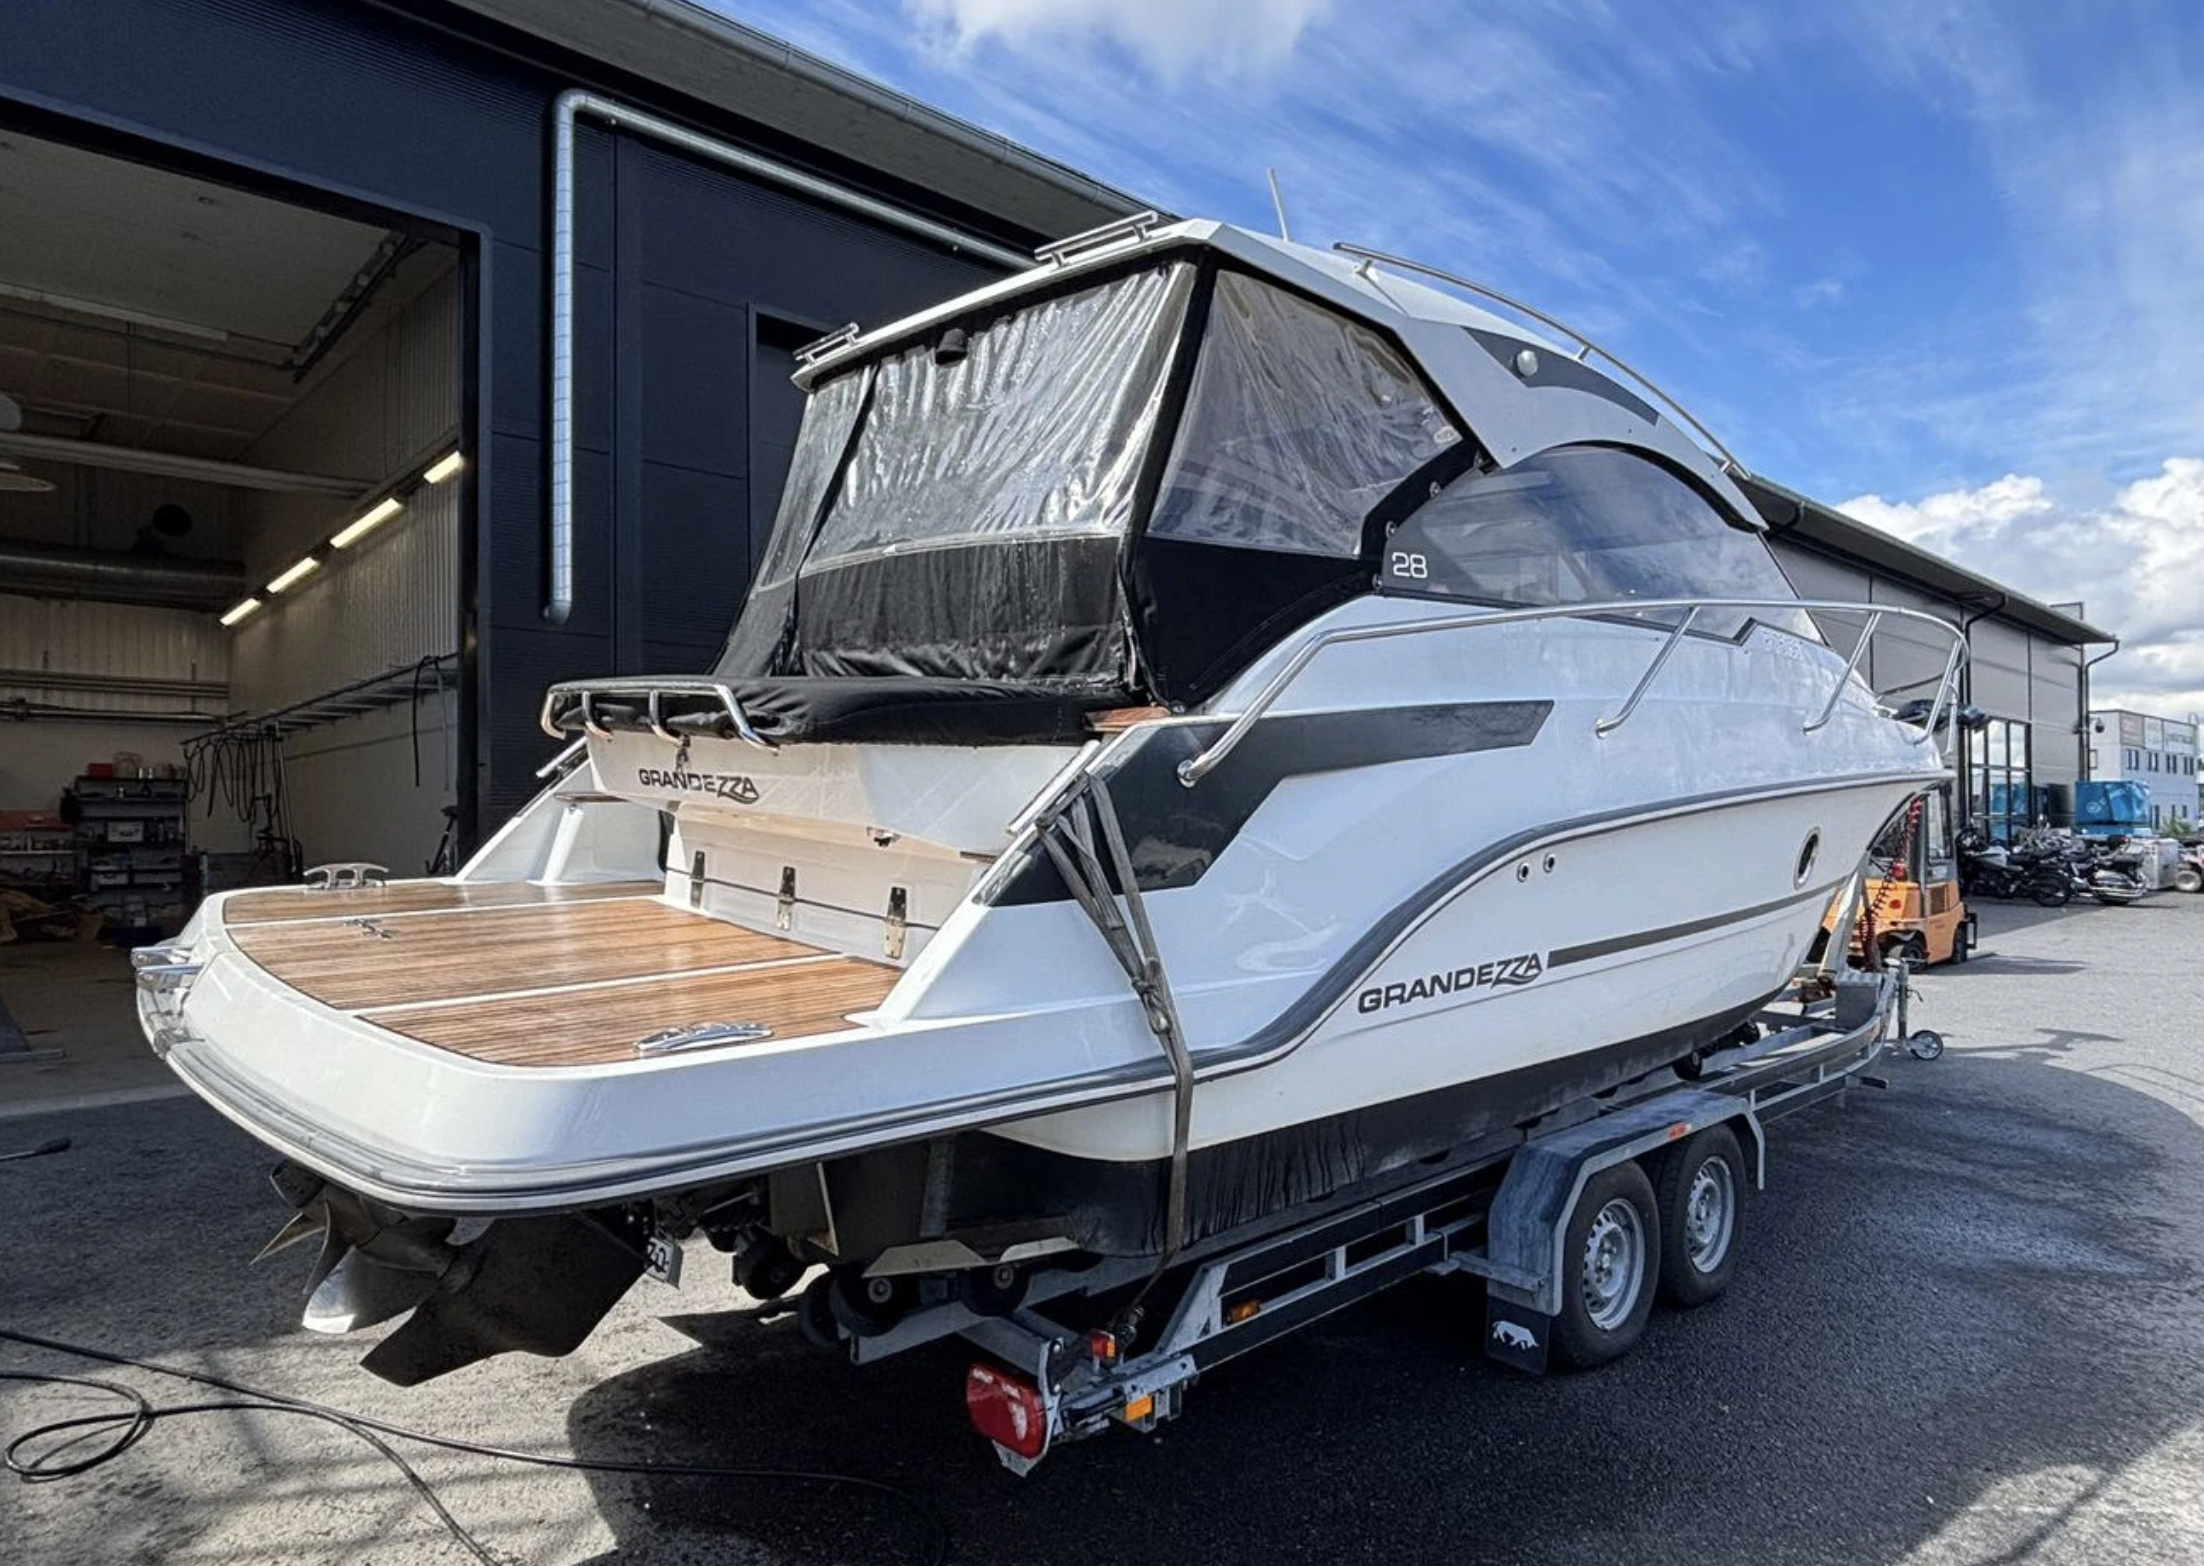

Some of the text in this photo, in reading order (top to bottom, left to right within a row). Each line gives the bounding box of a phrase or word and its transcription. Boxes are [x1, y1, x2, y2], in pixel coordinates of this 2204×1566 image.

[1392, 552, 1428, 579] 28
[638, 768, 760, 804] GRANDEZZA
[1357, 952, 1543, 1014] GRANDEZZA
